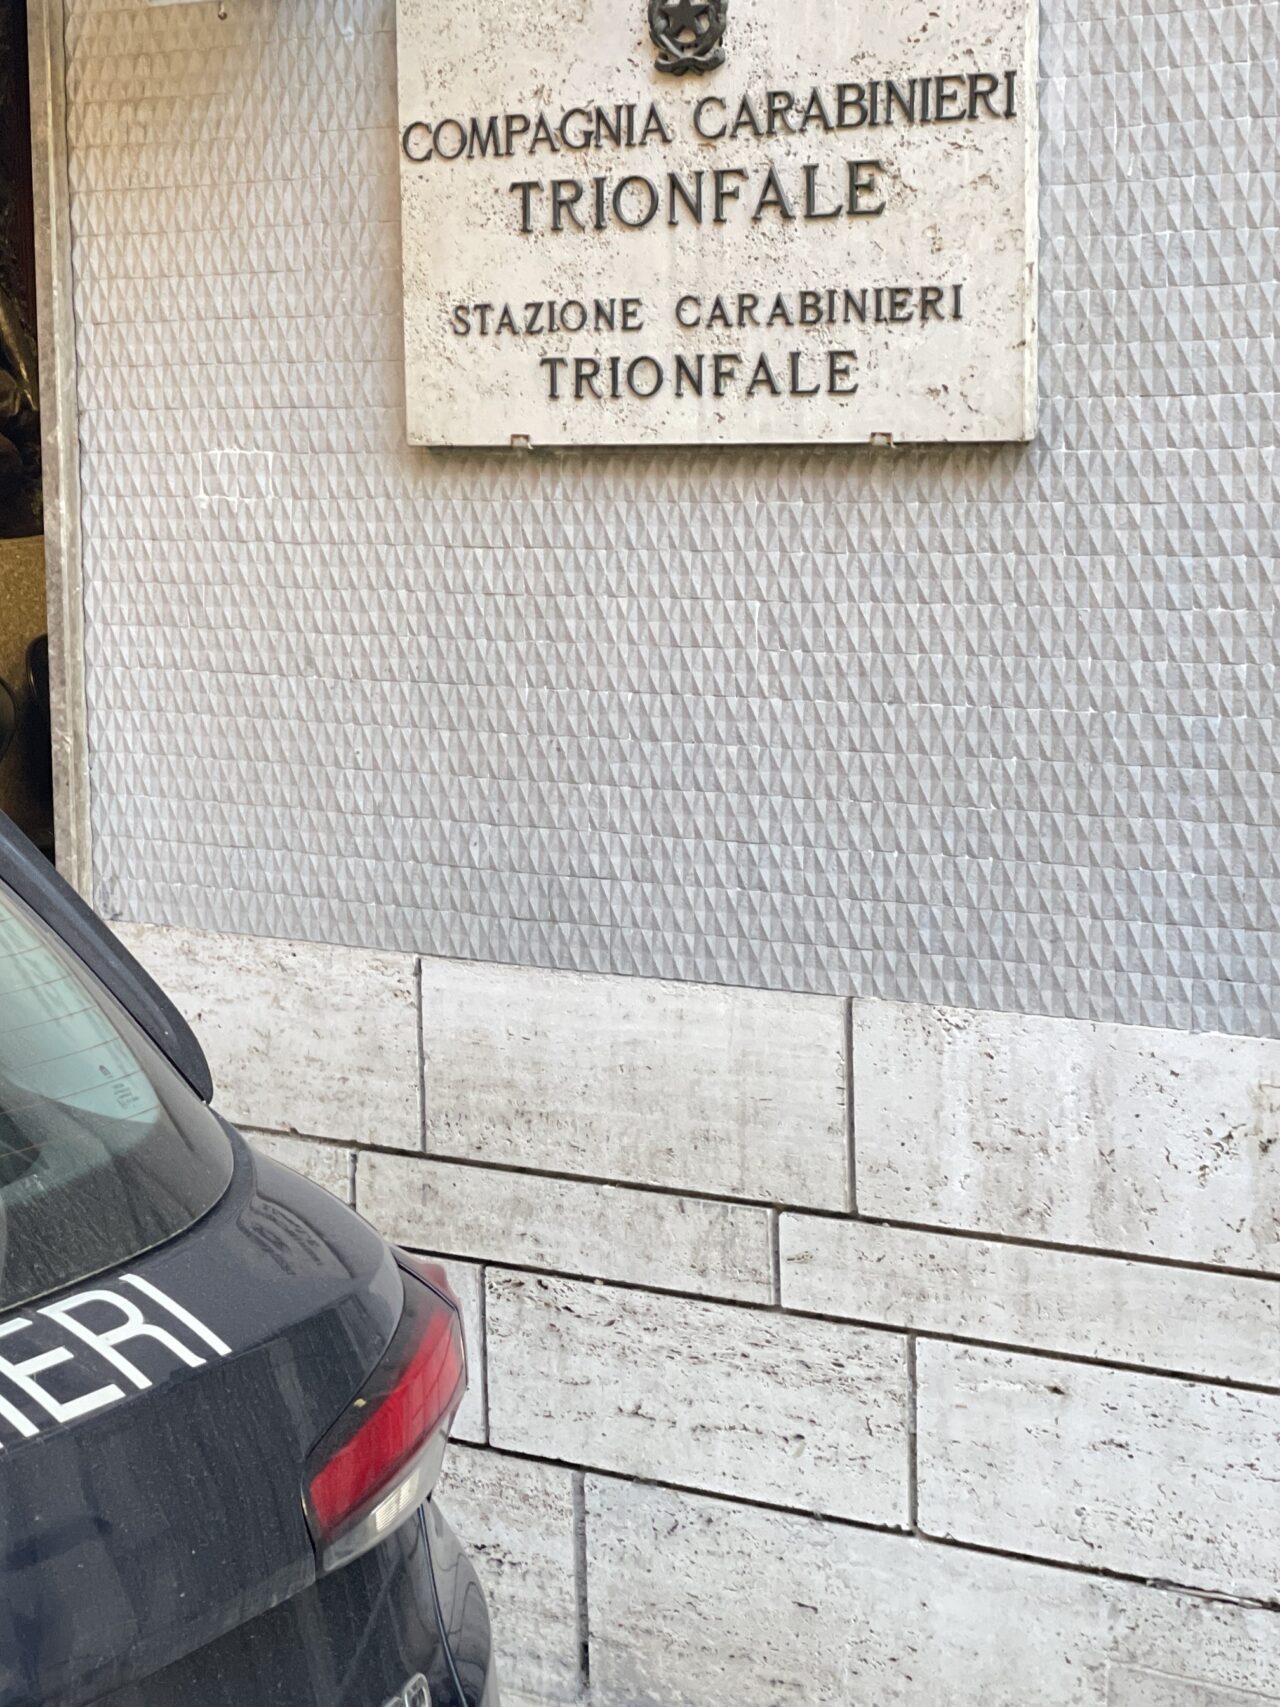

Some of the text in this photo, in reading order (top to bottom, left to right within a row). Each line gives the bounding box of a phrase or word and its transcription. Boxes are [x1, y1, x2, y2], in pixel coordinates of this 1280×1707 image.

[402, 70, 1018, 163] COMPAGNIA CARABINIERI
[509, 159, 887, 233] TRIONFALE
[451, 283, 964, 337] STAZIONE CARABINIERI
[539, 349, 860, 400] TRIONFALE
